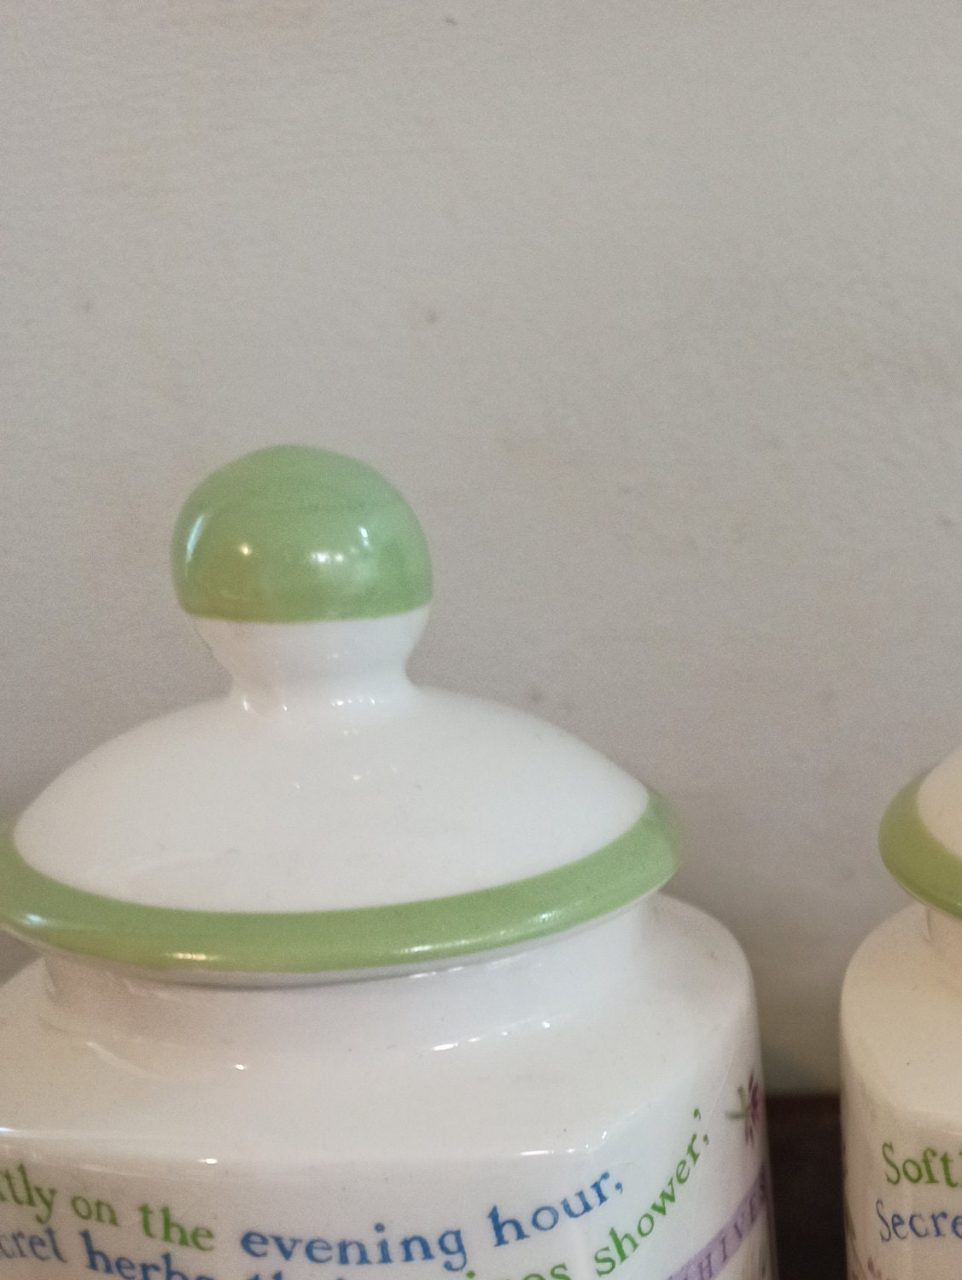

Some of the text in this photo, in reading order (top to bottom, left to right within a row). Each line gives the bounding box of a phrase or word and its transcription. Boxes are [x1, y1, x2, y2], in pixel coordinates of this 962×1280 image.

[0, 1164, 623, 1272] tly on the evening hour,
[0, 1227, 67, 1263] cret
